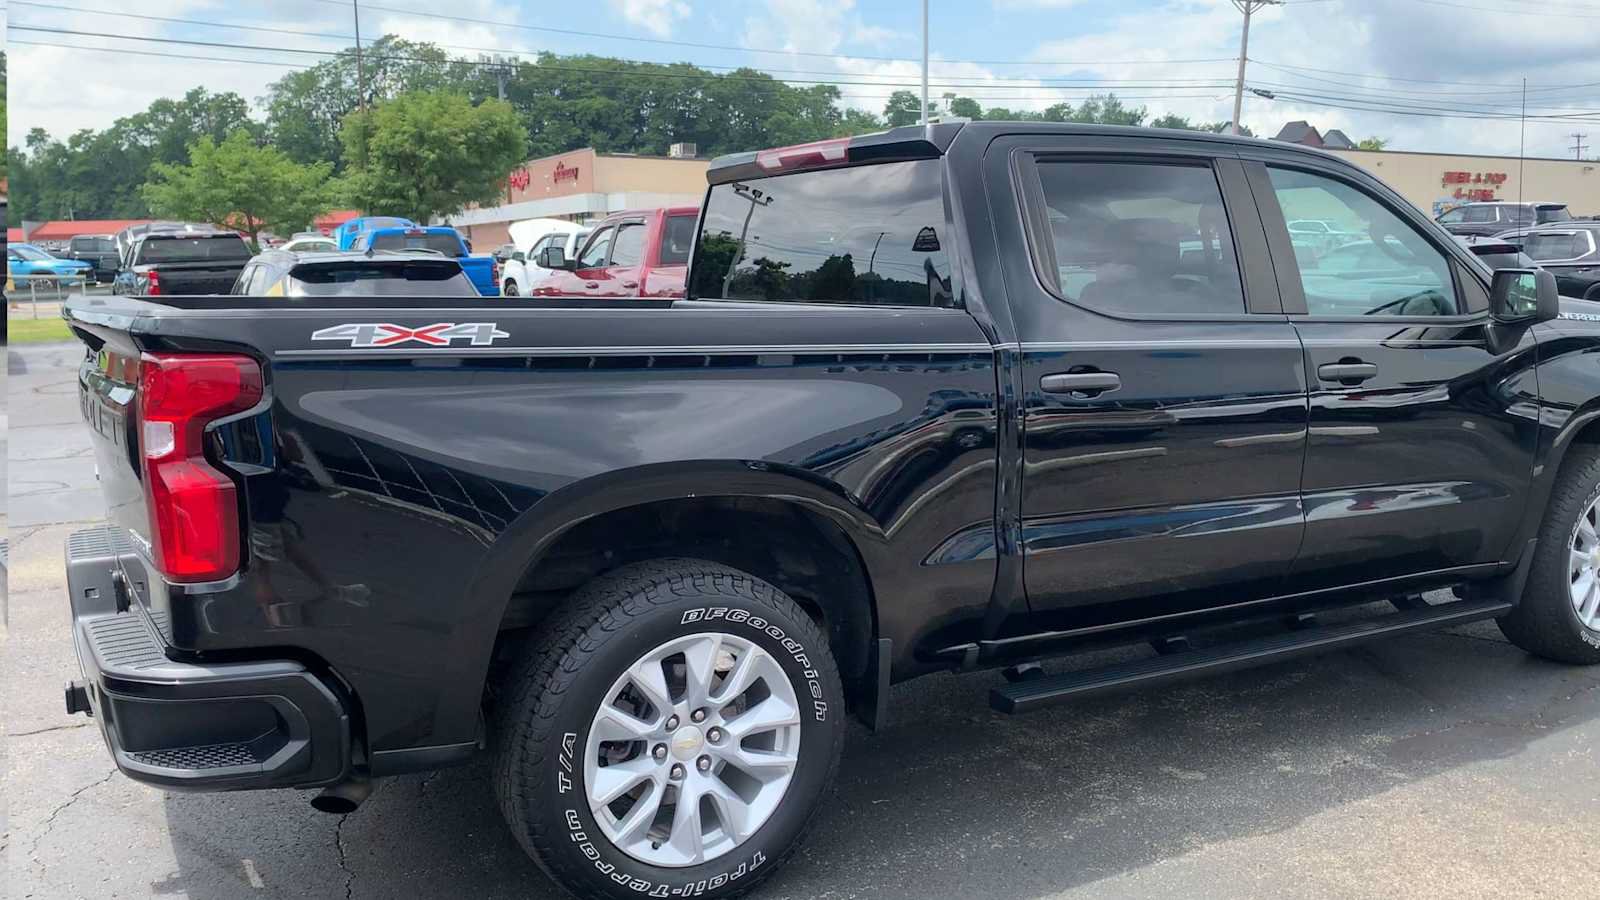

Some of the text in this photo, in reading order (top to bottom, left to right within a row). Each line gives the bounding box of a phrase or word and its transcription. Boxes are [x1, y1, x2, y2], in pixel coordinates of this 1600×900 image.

[681, 607, 827, 722] BFGoodrich
[558, 732, 767, 898] Trail-Terrain T/A
